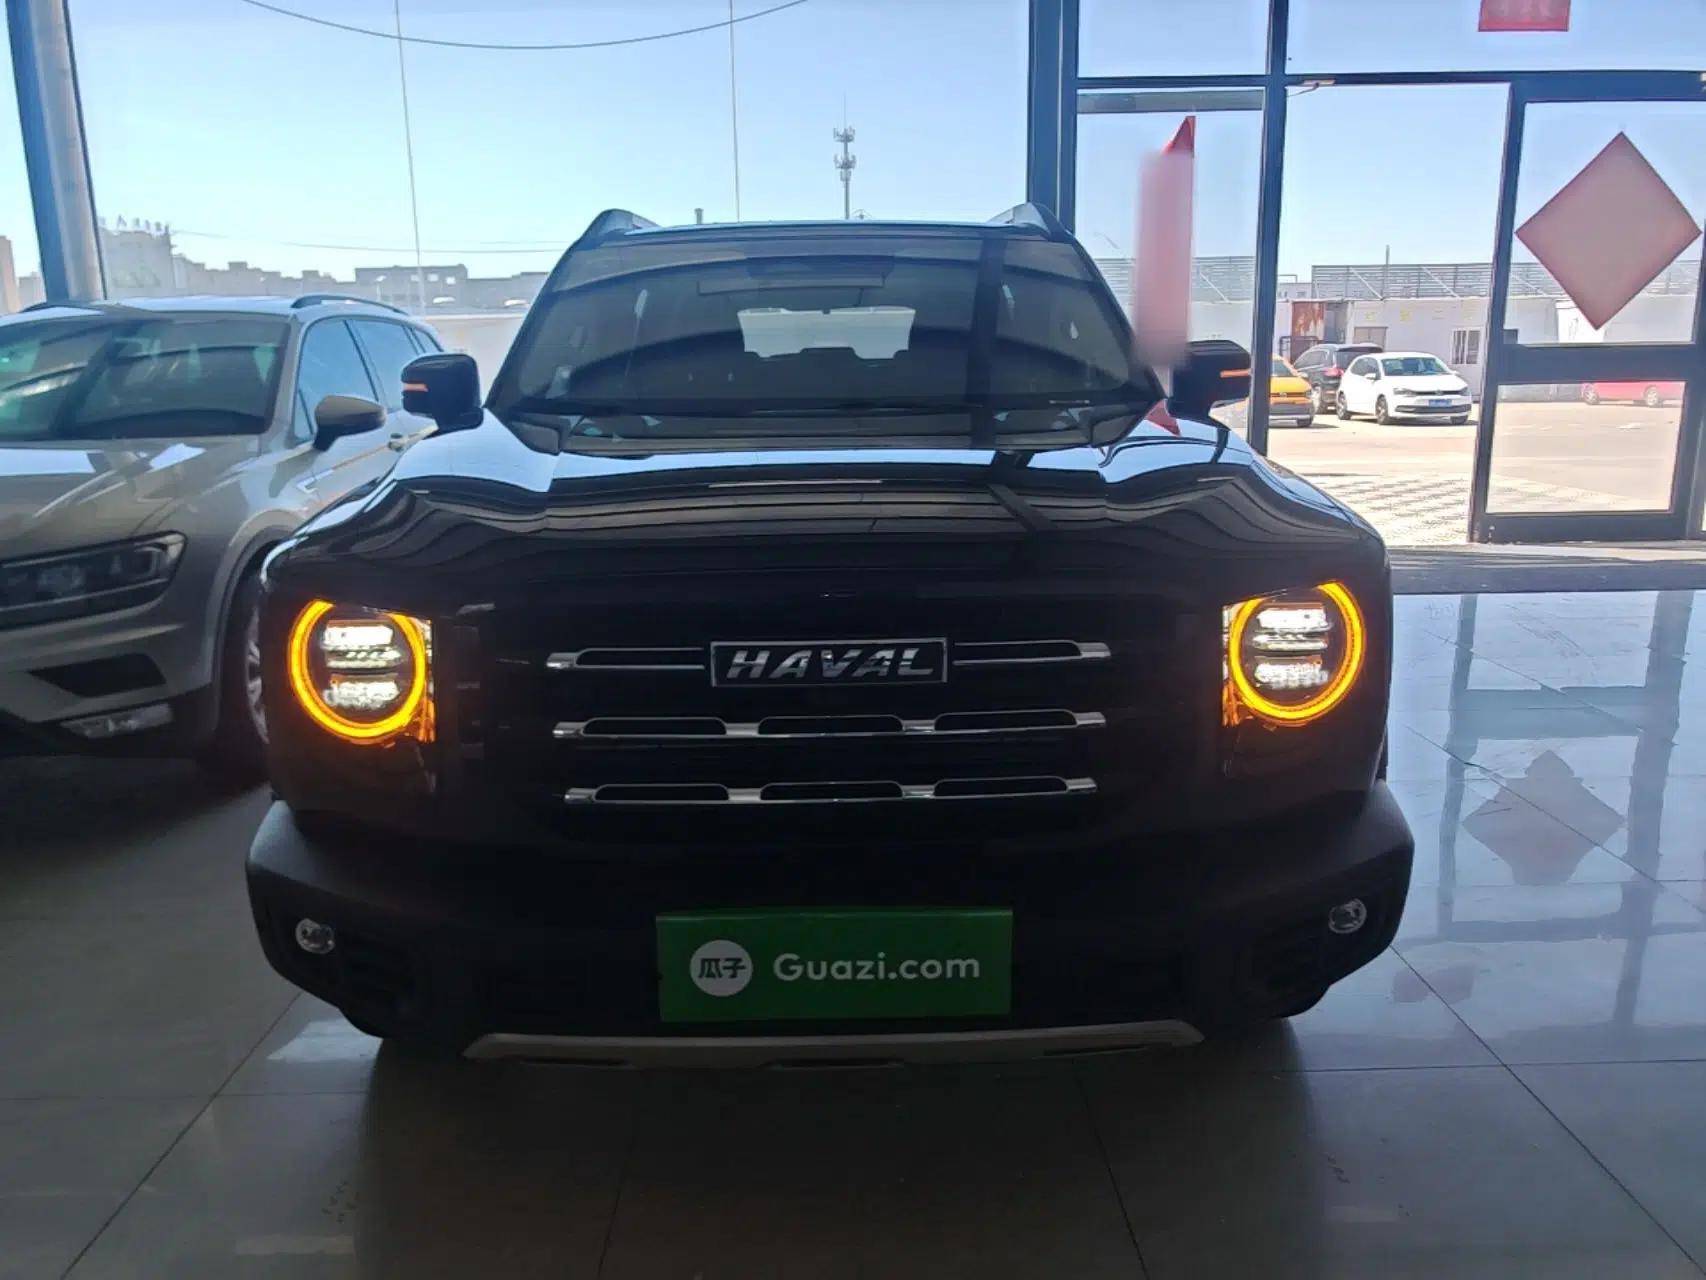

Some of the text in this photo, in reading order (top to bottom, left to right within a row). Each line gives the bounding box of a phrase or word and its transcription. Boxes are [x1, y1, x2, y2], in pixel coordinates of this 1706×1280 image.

[726, 648, 933, 679] HAVAL
[698, 957, 747, 979] 瓜子
[773, 952, 980, 981] Guazi.com
